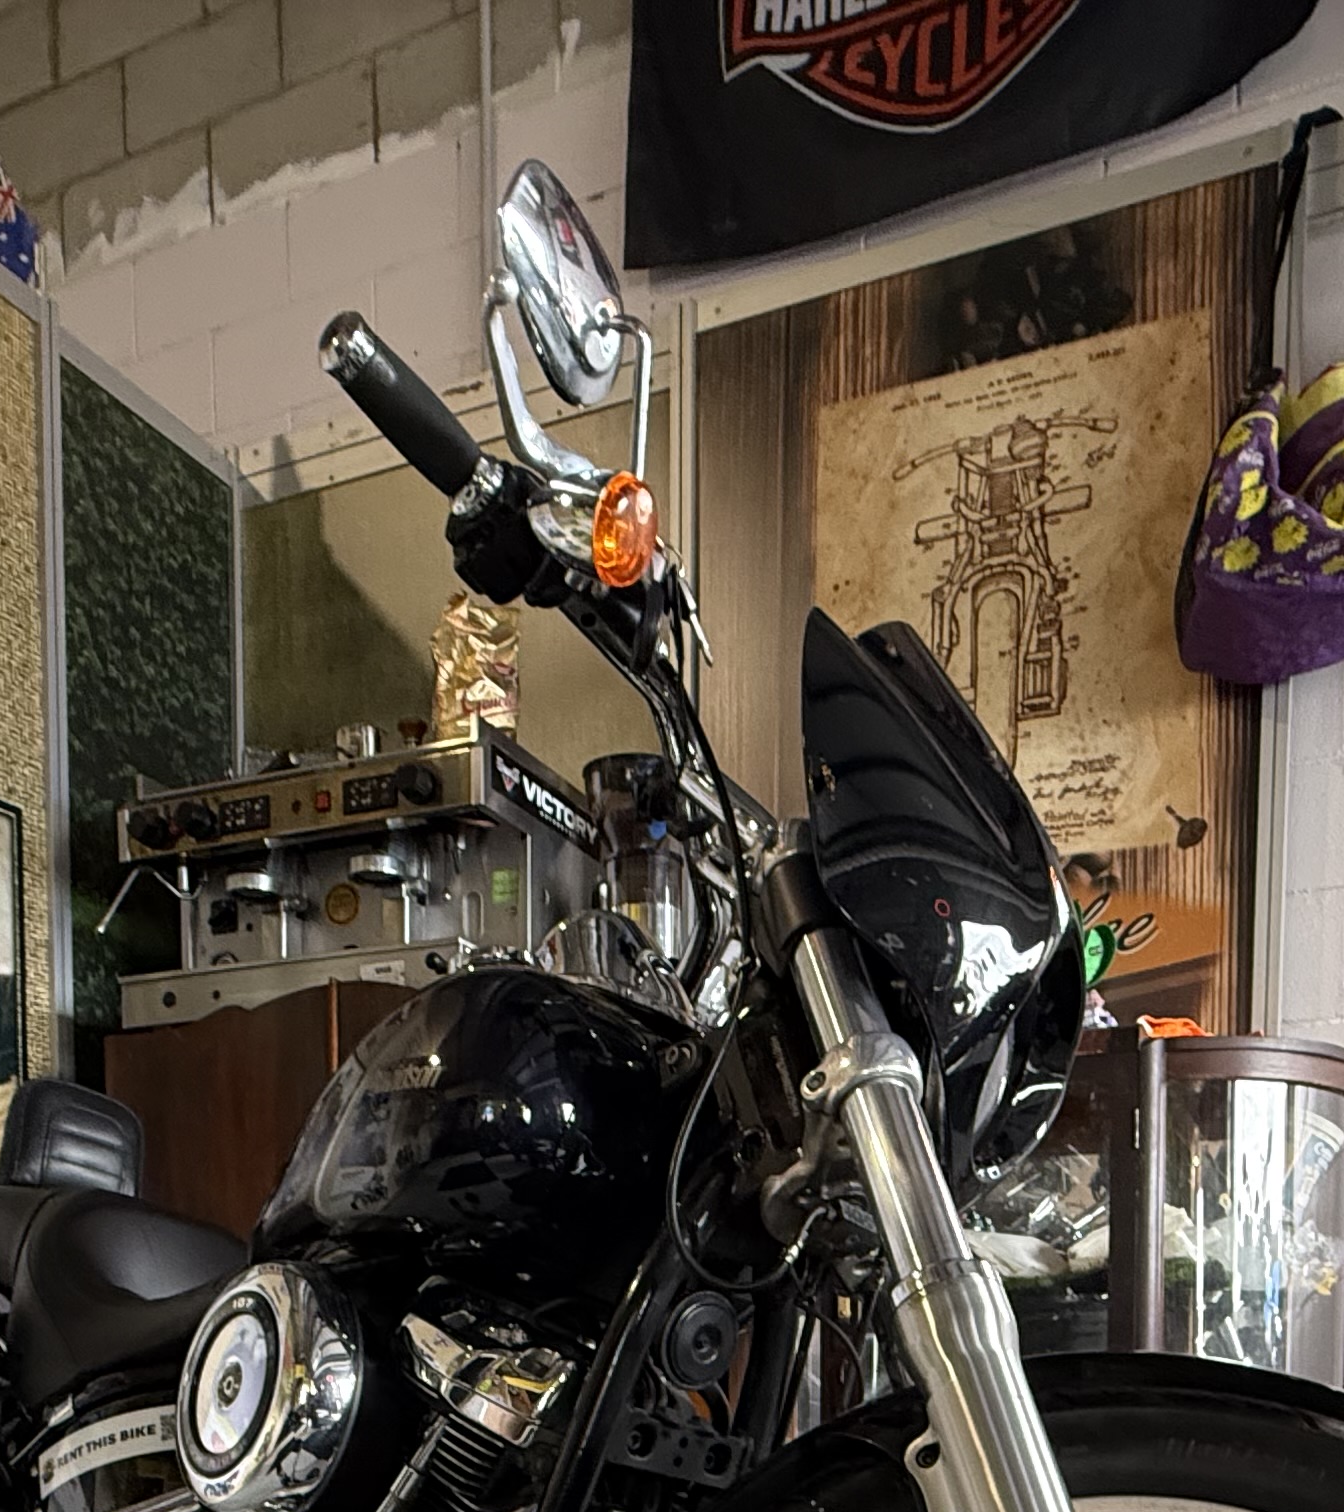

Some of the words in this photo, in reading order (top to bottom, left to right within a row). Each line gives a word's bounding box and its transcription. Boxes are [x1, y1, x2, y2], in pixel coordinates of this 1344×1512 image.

[843, 0, 1051, 96] CYCLE
[522, 773, 598, 845] VICTORY
[57, 1445, 84, 1468] RENT
[85, 1433, 117, 1454] THIS
[120, 1423, 157, 1443] BIKE
